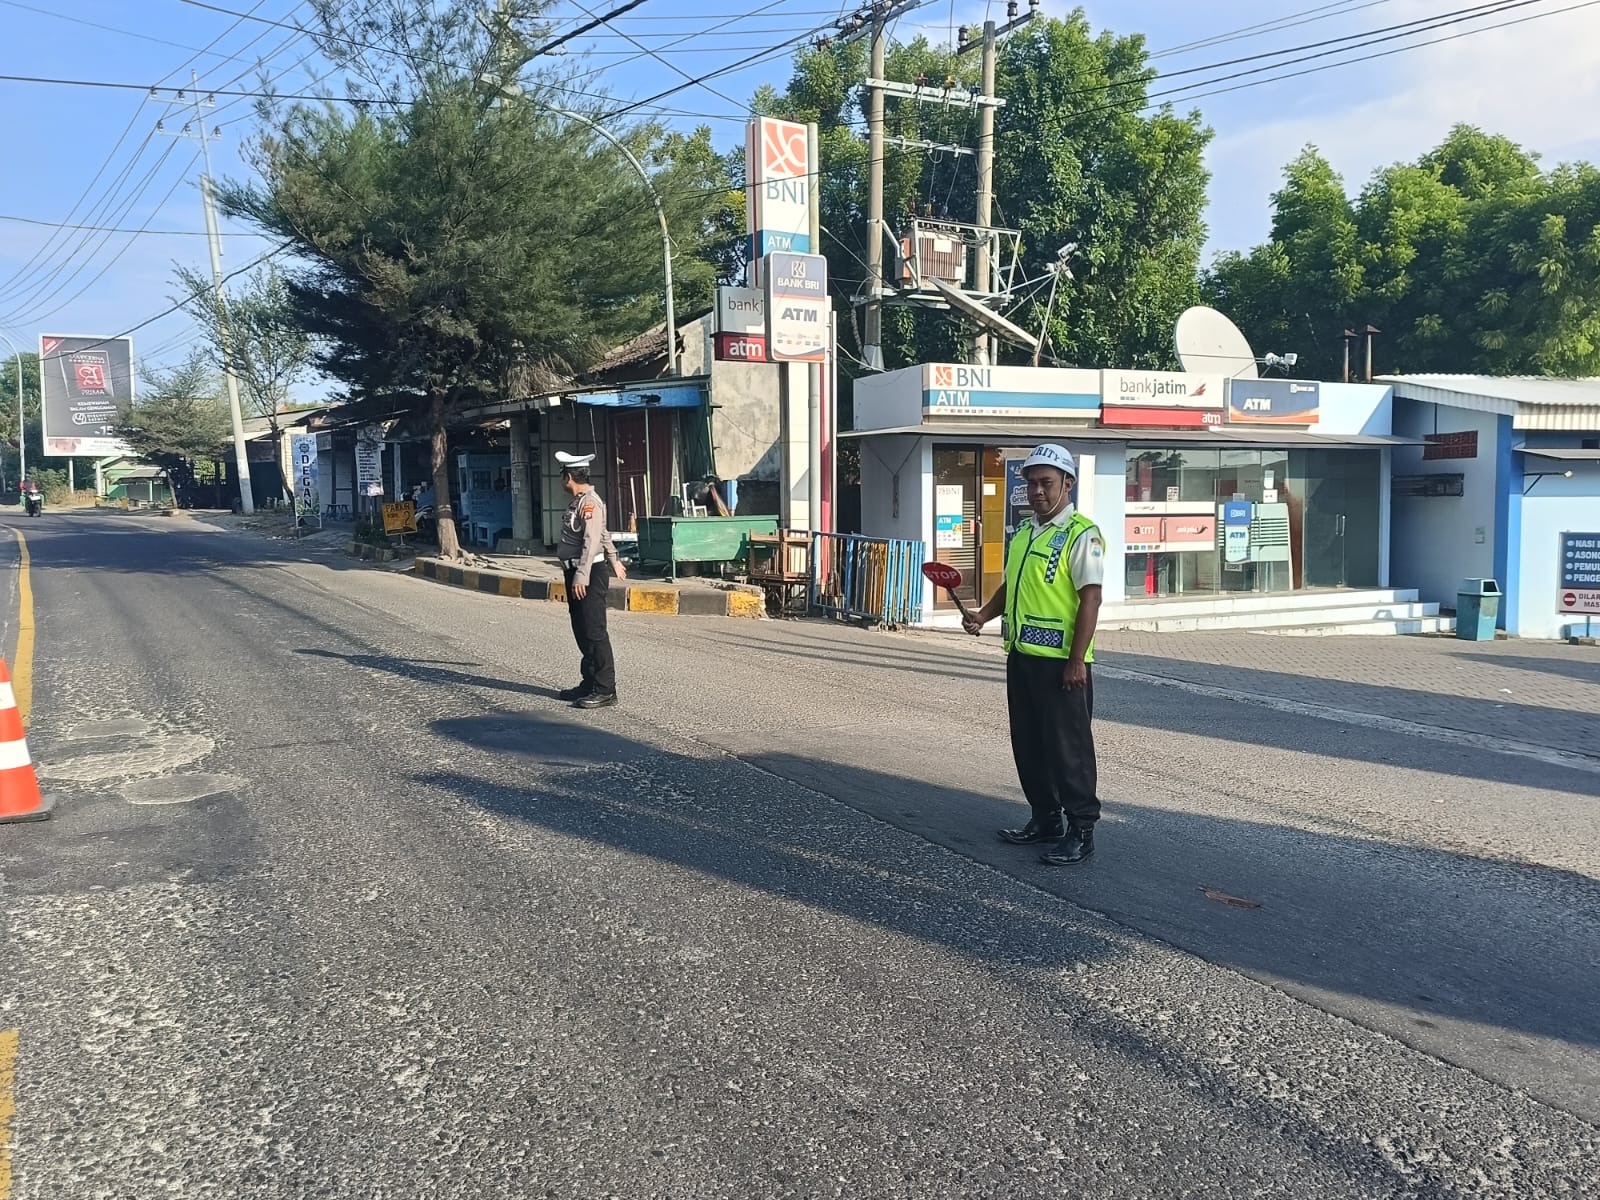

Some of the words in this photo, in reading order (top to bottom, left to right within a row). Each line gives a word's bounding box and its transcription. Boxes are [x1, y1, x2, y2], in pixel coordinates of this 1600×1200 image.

[766, 176, 805, 205] BNI
[767, 235, 791, 249] ATM
[777, 277, 804, 289] BANK
[805, 280, 819, 290] BRI
[781, 307, 817, 322] ATM
[729, 340, 762, 357] atm
[956, 367, 991, 388] BNI
[1120, 377, 1187, 398] bankjatim
[936, 390, 970, 406] ATM
[1243, 398, 1271, 410] ATM
[1201, 412, 1221, 424] atm
[301, 454, 312, 509] DEGAN
[1133, 525, 1155, 535] atm
[1575, 540, 1595, 548] NASI
[924, 570, 957, 579] STOP
